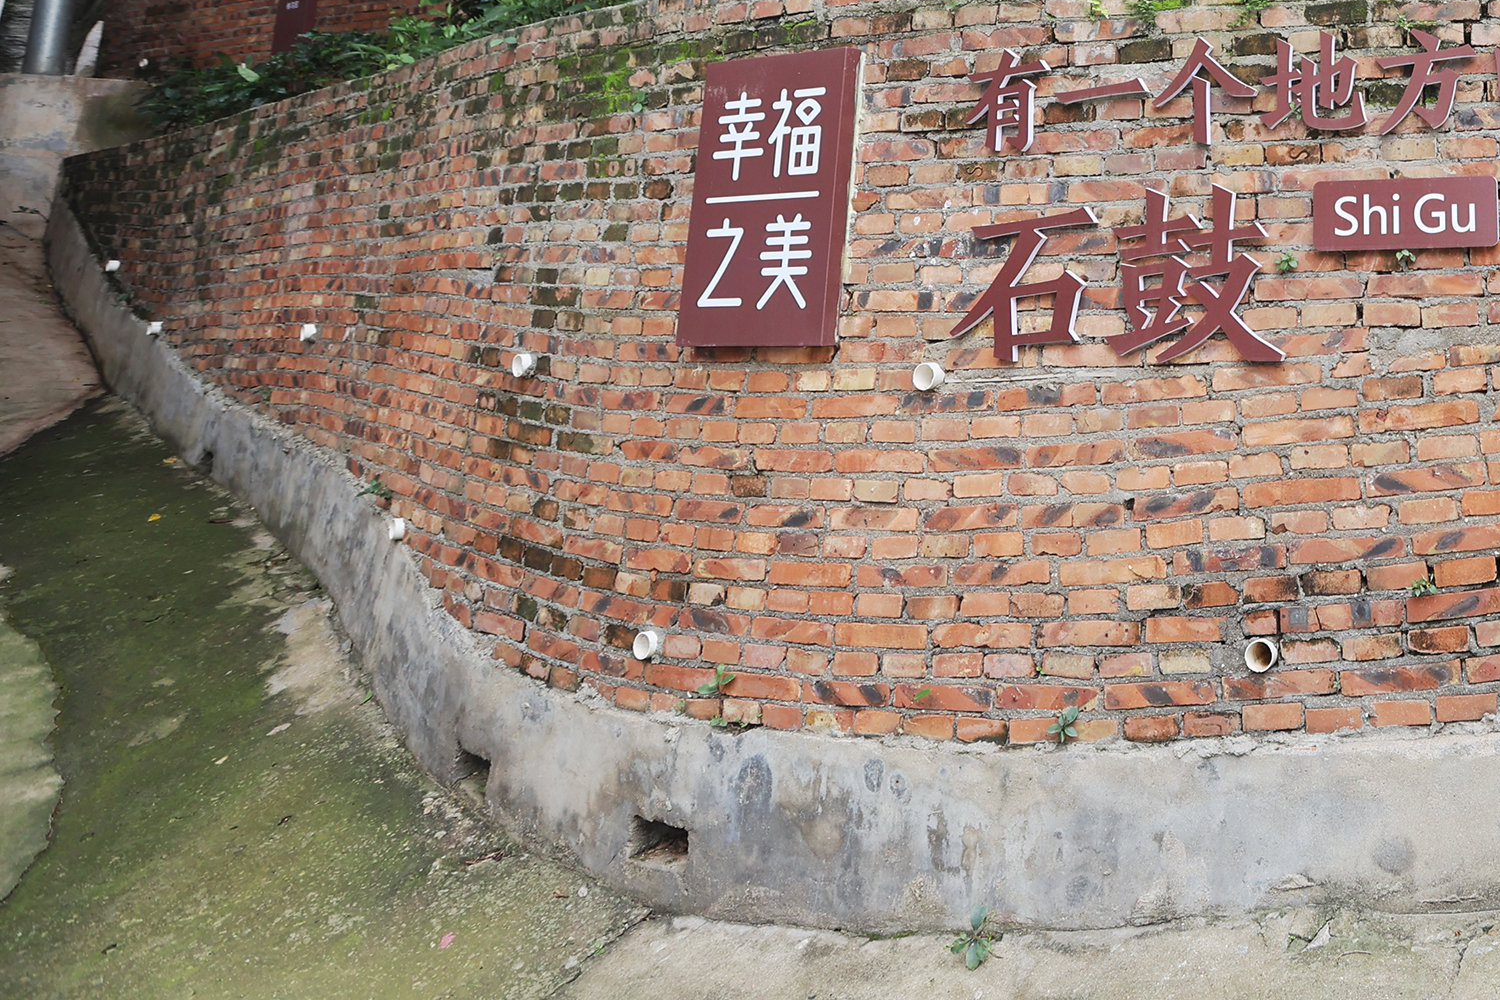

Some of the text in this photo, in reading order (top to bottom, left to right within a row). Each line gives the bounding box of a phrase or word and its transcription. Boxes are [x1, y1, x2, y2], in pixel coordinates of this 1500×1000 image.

[712, 86, 827, 182] 幸福
[696, 212, 813, 311] 之美
[1333, 192, 1477, 237] Shi Gu
[949, 182, 1287, 364] 石鼓
